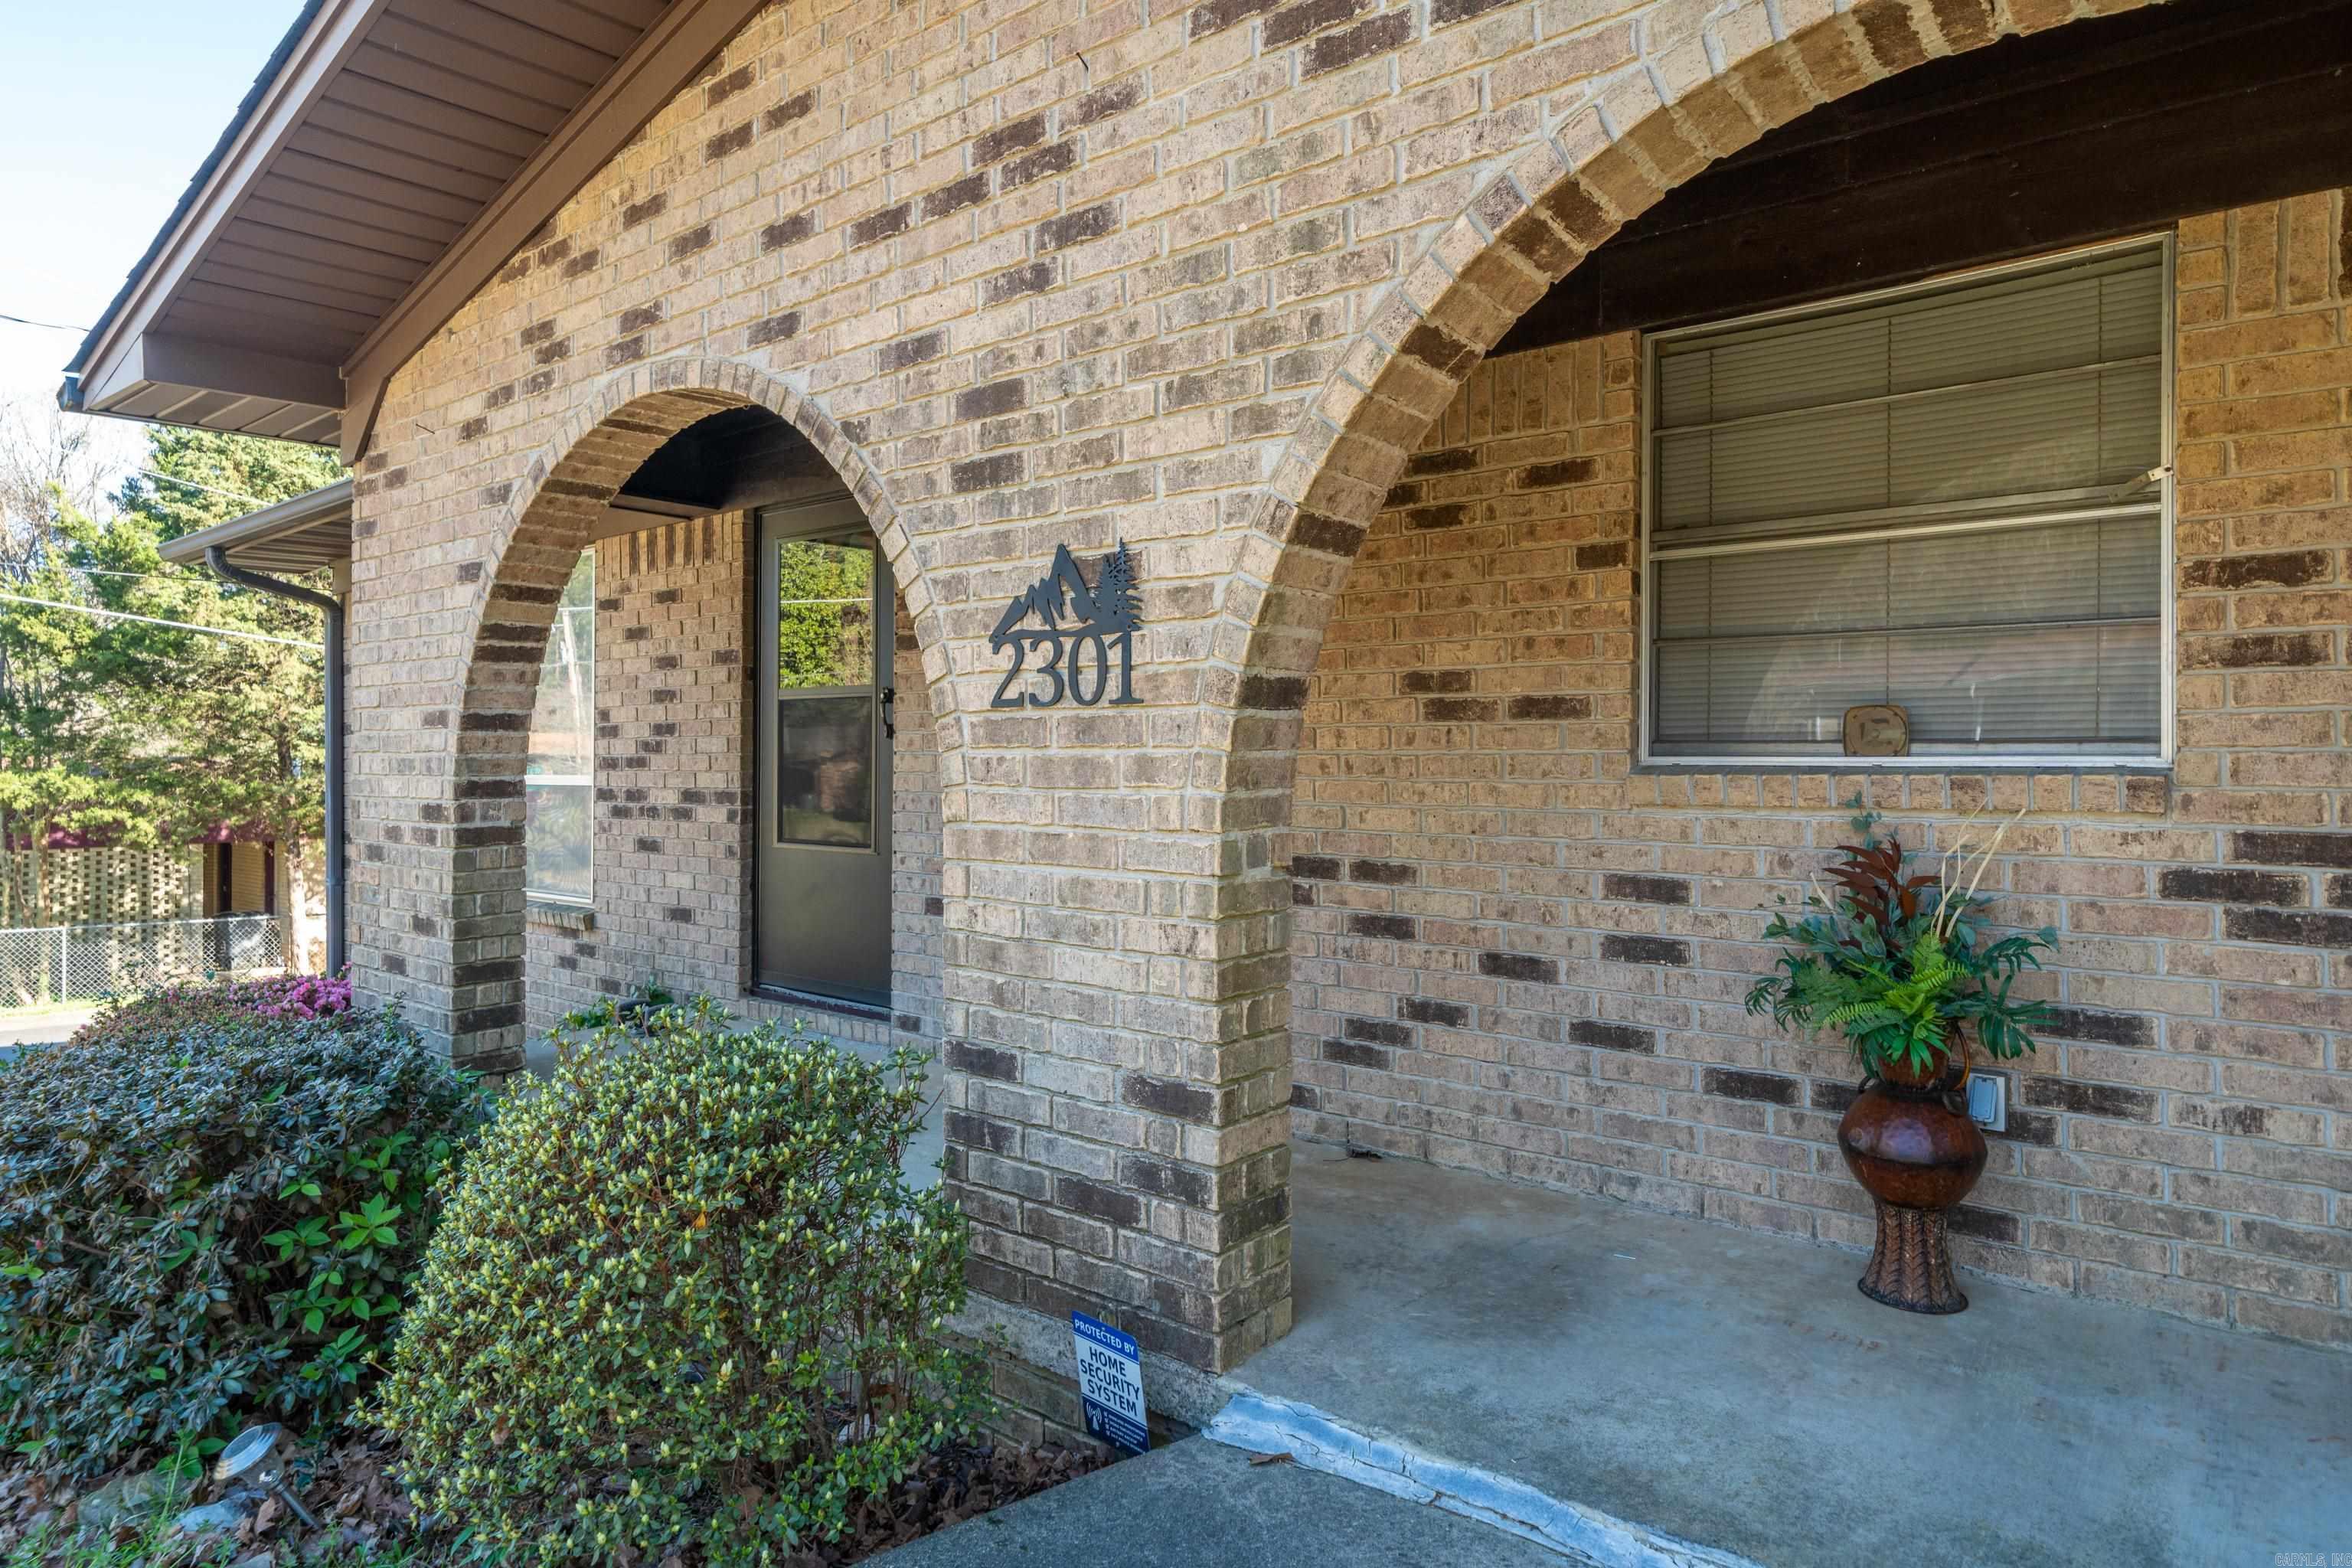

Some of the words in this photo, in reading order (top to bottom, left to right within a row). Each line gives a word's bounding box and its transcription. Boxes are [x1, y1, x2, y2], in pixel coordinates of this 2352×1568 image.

[991, 634, 1144, 707] 2301
[1074, 1318, 1122, 1348] PROTECTED
[1124, 1342, 1135, 1355] BY
[1080, 1359, 1140, 1400] SECURITY
[1089, 1347, 1126, 1377] HOME
[1087, 1379, 1137, 1416] SYSTEM
